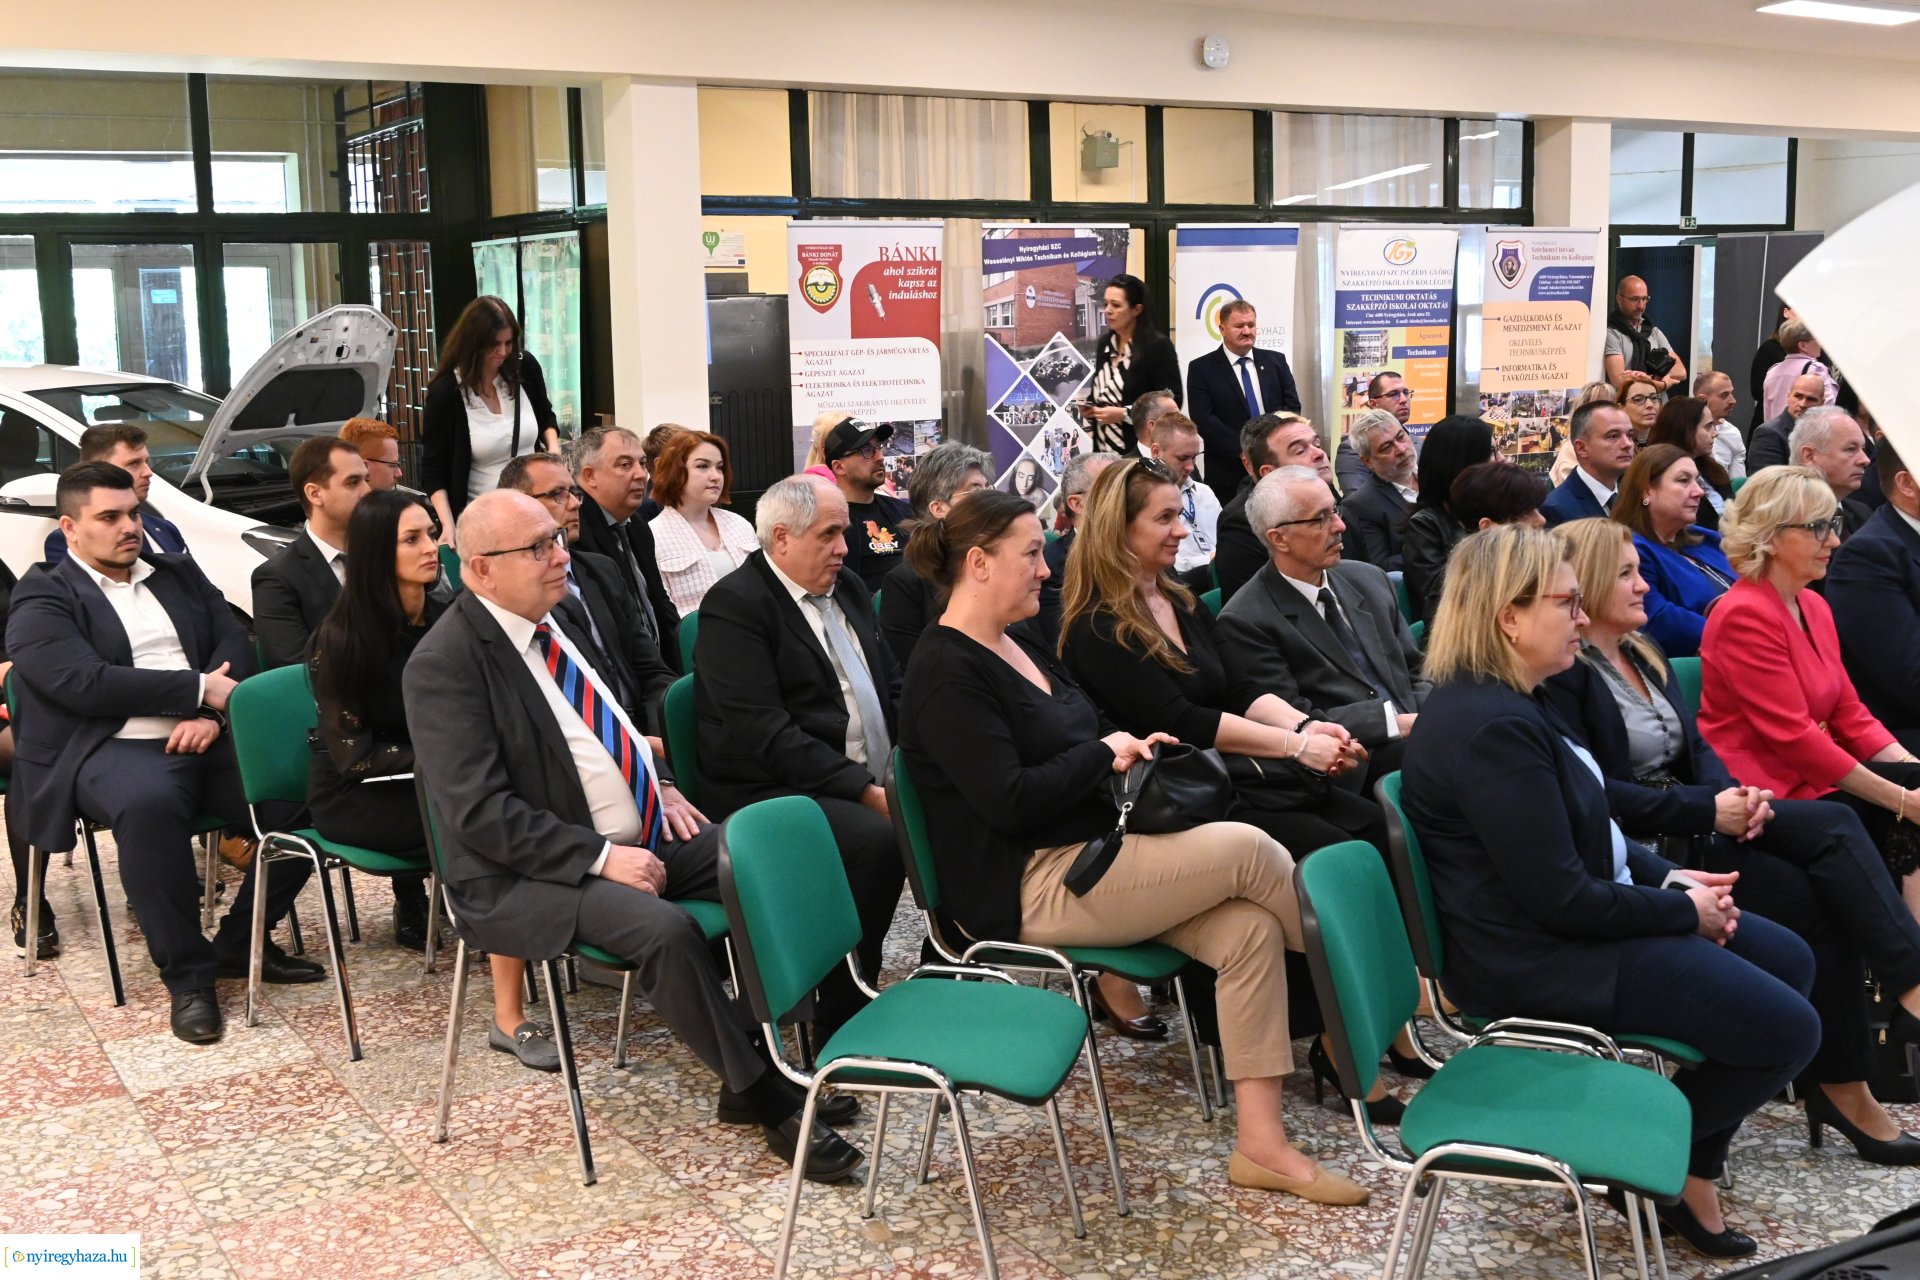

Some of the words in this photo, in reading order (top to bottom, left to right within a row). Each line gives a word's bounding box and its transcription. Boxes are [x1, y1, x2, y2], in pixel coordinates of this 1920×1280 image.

[879, 242, 937, 261] BÁNKI
[1034, 253, 1062, 261] Technikum
[1070, 250, 1097, 259] Kollégium
[884, 266, 904, 276] ahol
[907, 265, 937, 276] szikrát
[898, 278, 925, 289] kapsz
[889, 290, 937, 300] induláshoz
[1361, 293, 1404, 302] TECHNIKUMI
[1405, 291, 1437, 301] OKTATÁS
[1346, 302, 1387, 311] SZAKKÉPZŐ
[1389, 302, 1417, 310] ISKOLAI
[1418, 300, 1448, 309] OKTATÁS
[1503, 313, 1553, 323] GAZDÁLKODÁS
[1554, 313, 1563, 322] ÉS
[1256, 325, 1285, 336] GYHÁZI
[1503, 324, 1551, 332] MENEDZSMENT
[1553, 322, 1582, 331] ÁGAZAT
[1257, 339, 1284, 348] ÉPZÉSI
[804, 349, 850, 358] SPECIALIZÁLT
[1406, 348, 1436, 356] Technikum
[804, 358, 833, 366] ÁGAZAT
[1502, 363, 1547, 372] INFORMATIKA
[1549, 362, 1557, 371] ÉS
[804, 369, 837, 377] GÉPÉSZET
[1502, 372, 1539, 382] TÁVKÖZLÉS
[1540, 371, 1569, 380] ÁGAZAT
[805, 381, 851, 389] ELEKTRONIKA
[853, 380, 860, 388] ÉS
[862, 379, 926, 388] ELEKTROTECHNIKA
[806, 390, 834, 398] ÁGAZAT
